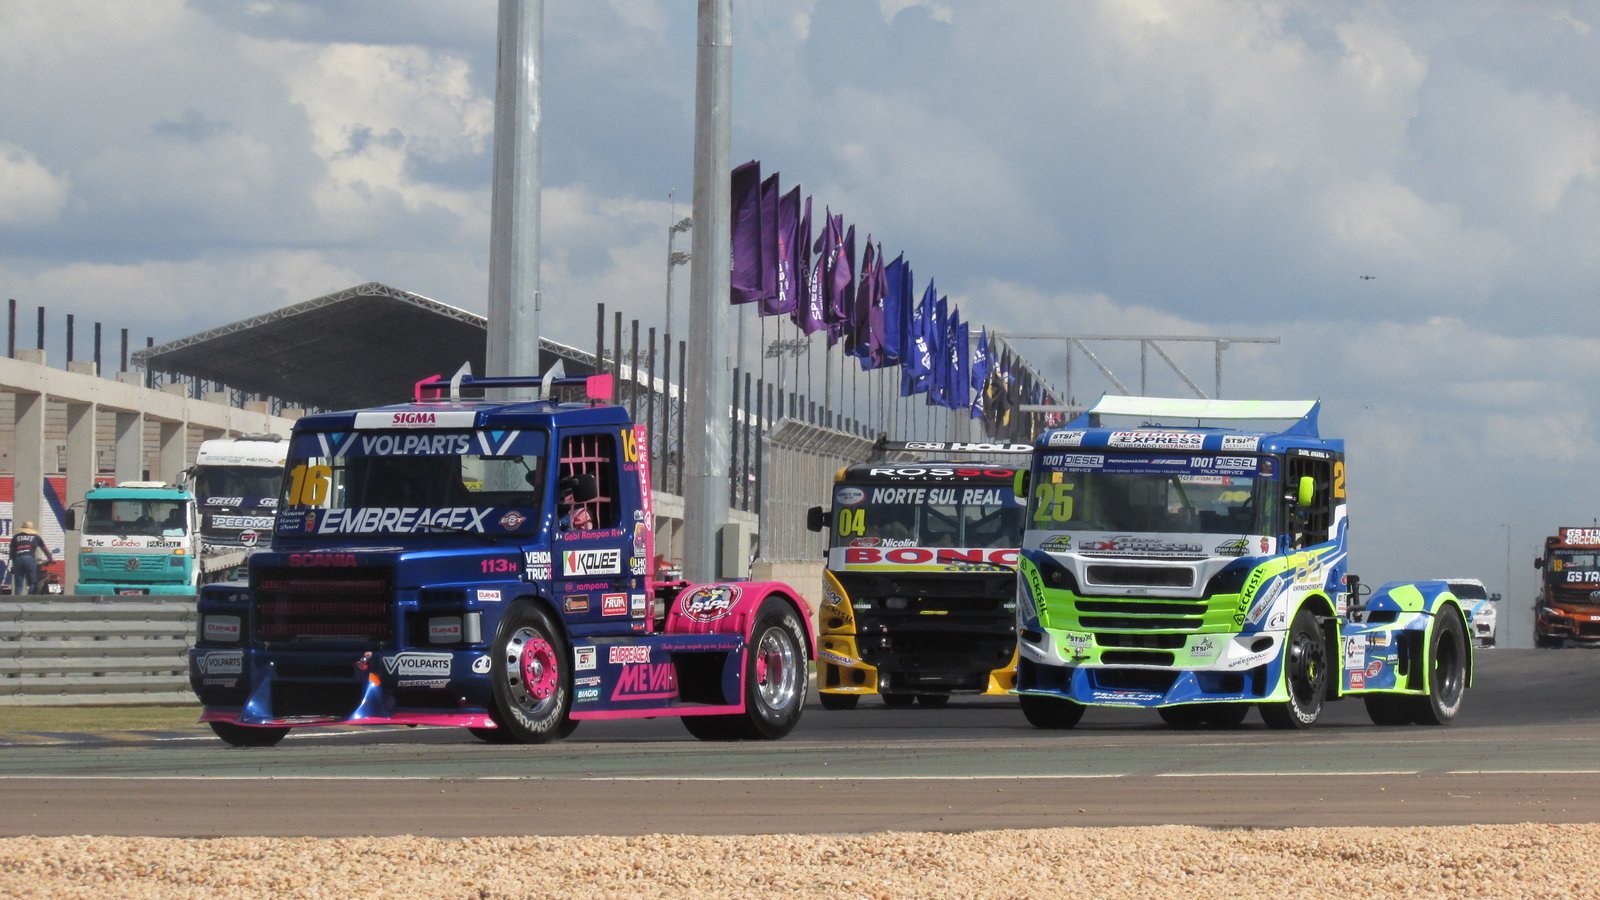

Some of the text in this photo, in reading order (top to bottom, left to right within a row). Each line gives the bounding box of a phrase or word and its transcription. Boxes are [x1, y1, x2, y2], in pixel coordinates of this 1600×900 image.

[392, 412, 436, 424] SIGMA
[362, 434, 470, 456] VOLPARTS
[621, 429, 638, 463] 16
[1042, 455, 1104, 465] 1001 DIESEL
[1190, 457, 1257, 468] 1001 DIESEL
[869, 468, 1015, 477] ROSSO
[287, 464, 332, 506] 16
[871, 488, 926, 504] NORTE
[928, 489, 956, 505] SUL
[962, 489, 1003, 505] REAL
[1034, 484, 1074, 521] 25
[318, 507, 494, 534] EMBREAGEX
[838, 508, 866, 537] 04
[16, 535, 34, 543] STAFF
[882, 538, 918, 548] Nicolini
[288, 553, 358, 567] SCANIA
[525, 552, 552, 564] VENDA
[576, 552, 618, 574] KOUBE
[526, 568, 552, 580] TRUCK
[1567, 571, 1583, 582] GS
[1030, 568, 1048, 617] ECKISIL
[1238, 567, 1264, 613] ECKISIL
[604, 598, 625, 608] FRUM
[400, 659, 449, 669] VOLPARTS
[1228, 653, 1267, 668] SPEEDMAX
[578, 690, 599, 699] BIAGIO
